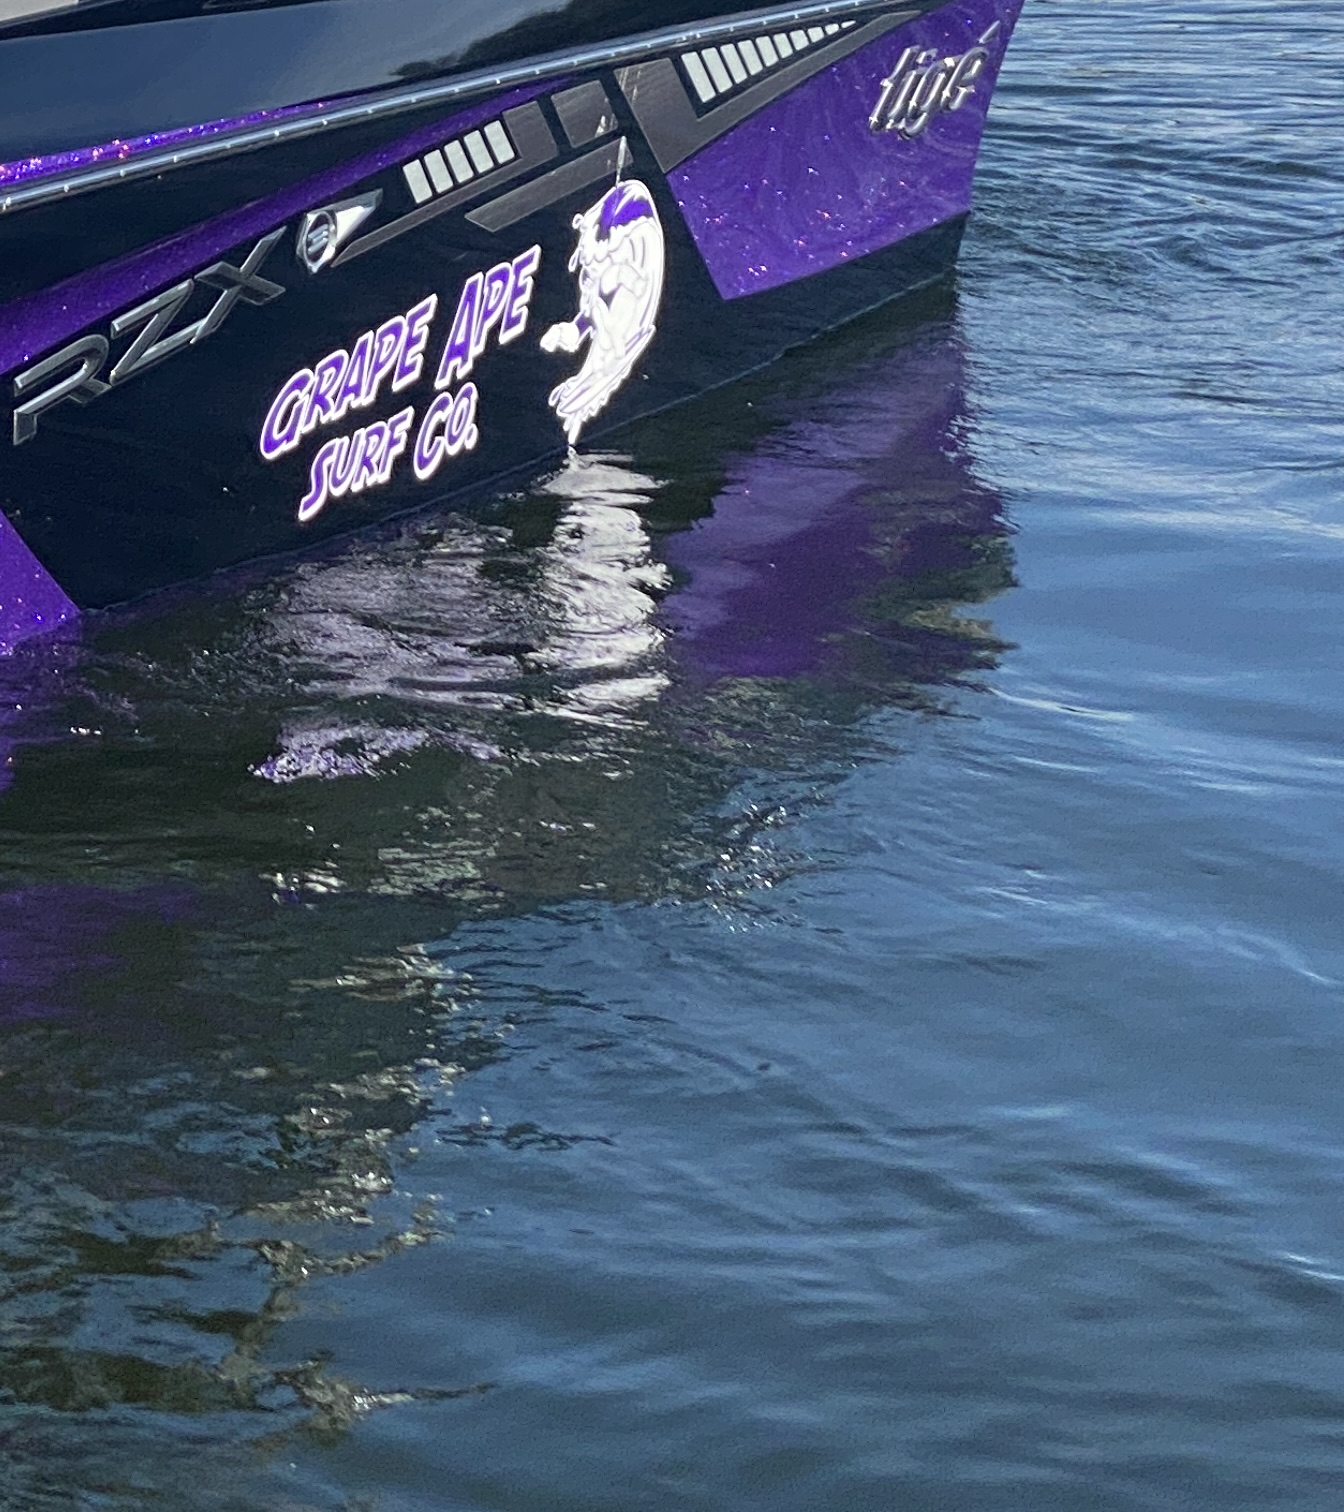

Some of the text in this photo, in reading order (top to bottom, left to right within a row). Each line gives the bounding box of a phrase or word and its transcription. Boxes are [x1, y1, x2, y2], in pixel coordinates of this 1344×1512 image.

[13, 225, 287, 446] RZX
[261, 244, 542, 460] GRAPE APE
[298, 382, 479, 521] SURF CO.
